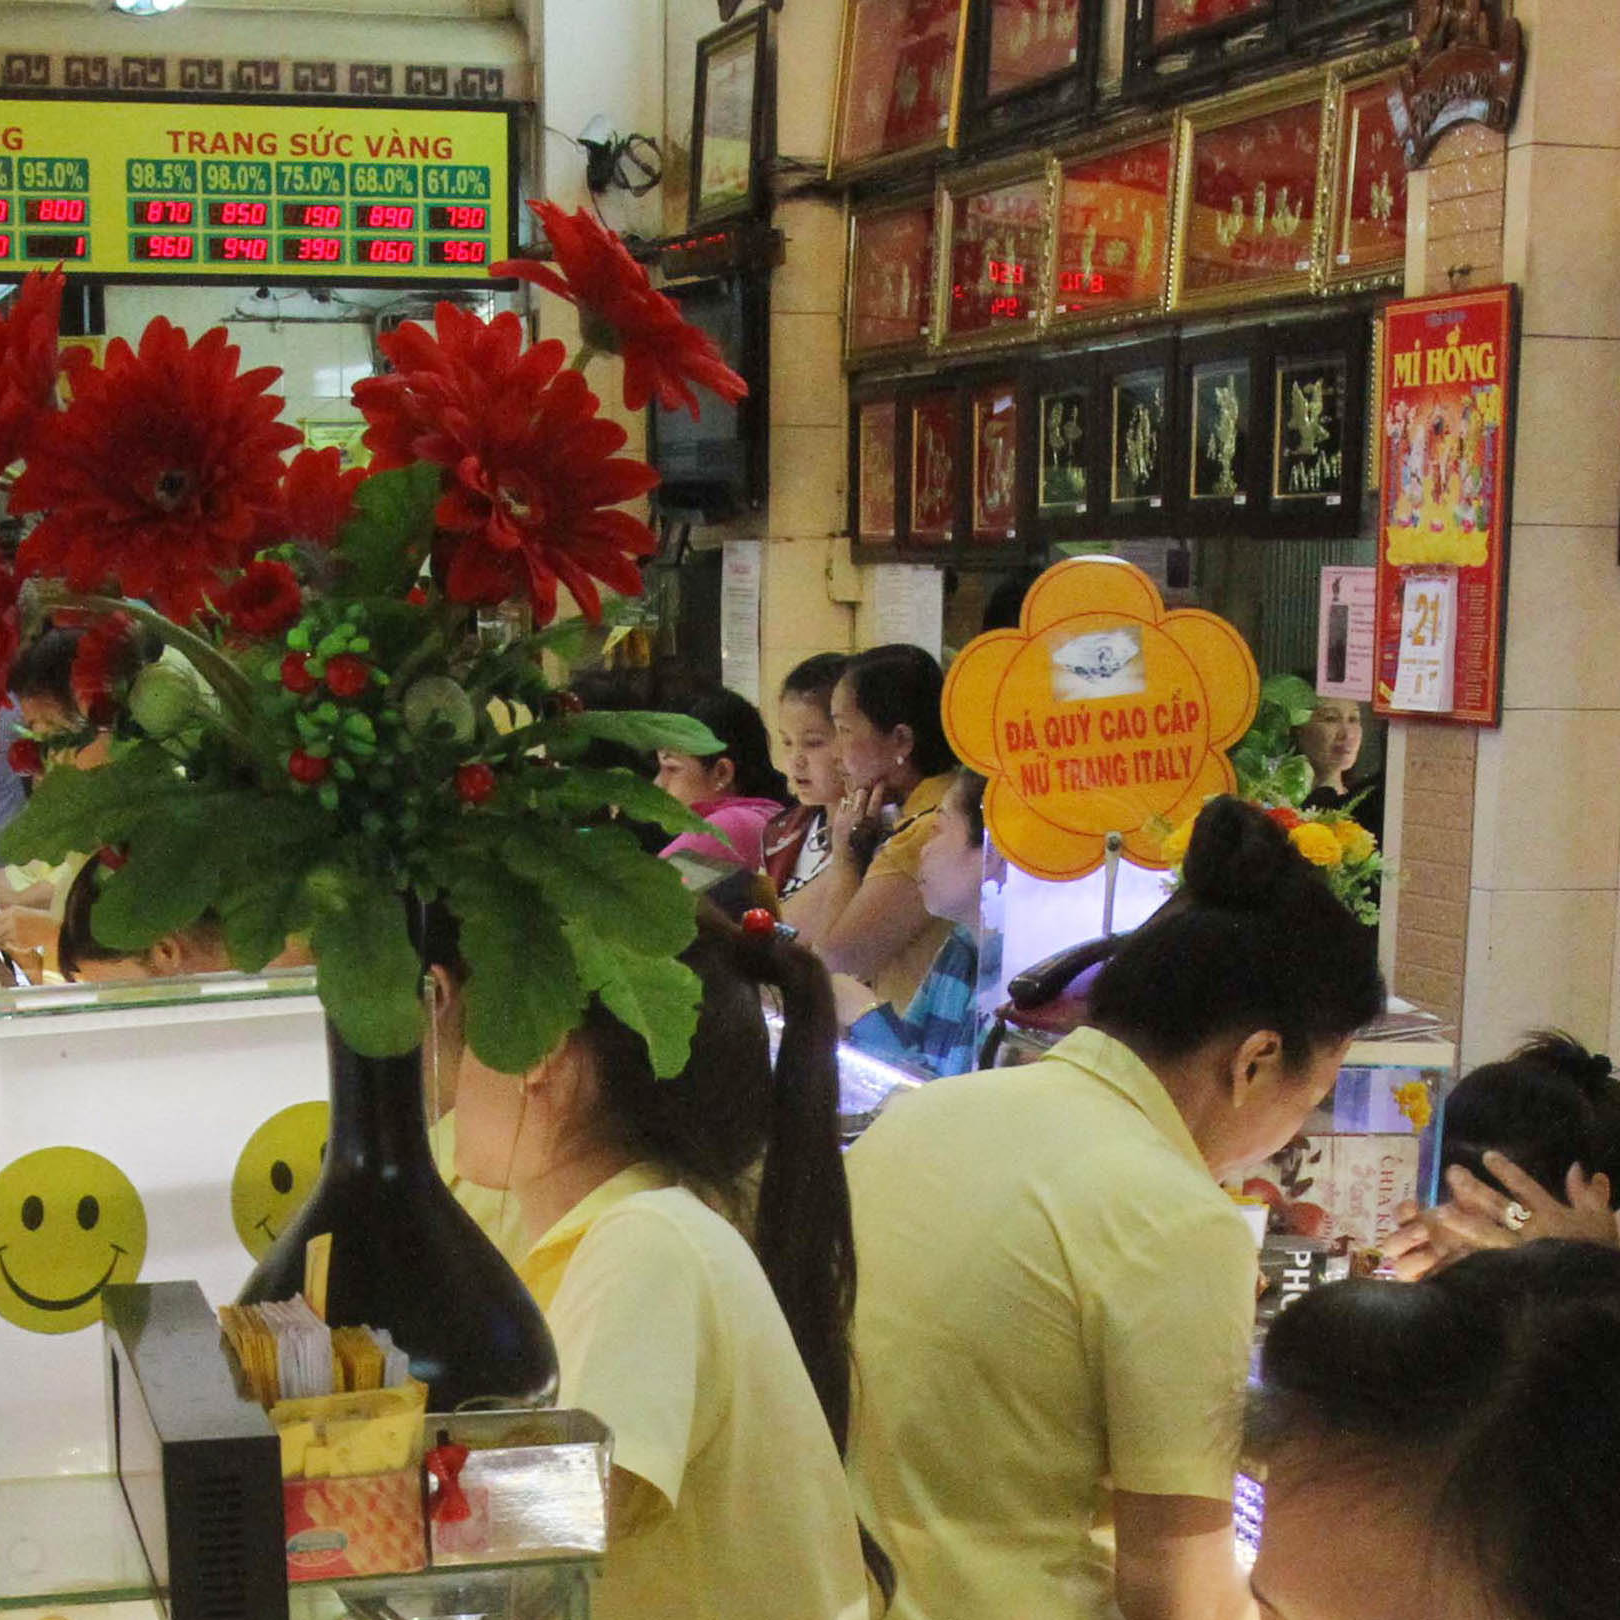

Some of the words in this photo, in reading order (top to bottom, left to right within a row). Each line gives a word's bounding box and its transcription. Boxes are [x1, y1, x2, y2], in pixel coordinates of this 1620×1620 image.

[167, 130, 277, 157] TRANG
[290, 126, 353, 157] SỨC
[365, 128, 454, 159] VÀNG
[23, 161, 84, 189] 95.0%
[131, 163, 191, 190] 98.5%
[206, 165, 267, 192] 98.0%
[281, 165, 341, 192] 75.0%
[354, 167, 414, 194] 68.0%
[427, 169, 486, 195] 61.0%
[39, 200, 85, 222] 800
[146, 201, 191, 223] 870
[220, 203, 268, 225] 850
[302, 205, 342, 228] 190
[367, 206, 415, 228] 890
[444, 206, 486, 229] 790
[224, 238, 268, 260] 940
[297, 239, 341, 261] 390
[1005, 710, 1038, 753] ĐÁ
[1044, 704, 1091, 749] QUÝ
[1100, 706, 1147, 742] CAO
[1154, 688, 1200, 736] CẤP
[1056, 752, 1128, 792] TRANG
[1133, 745, 1193, 784] ITALY
